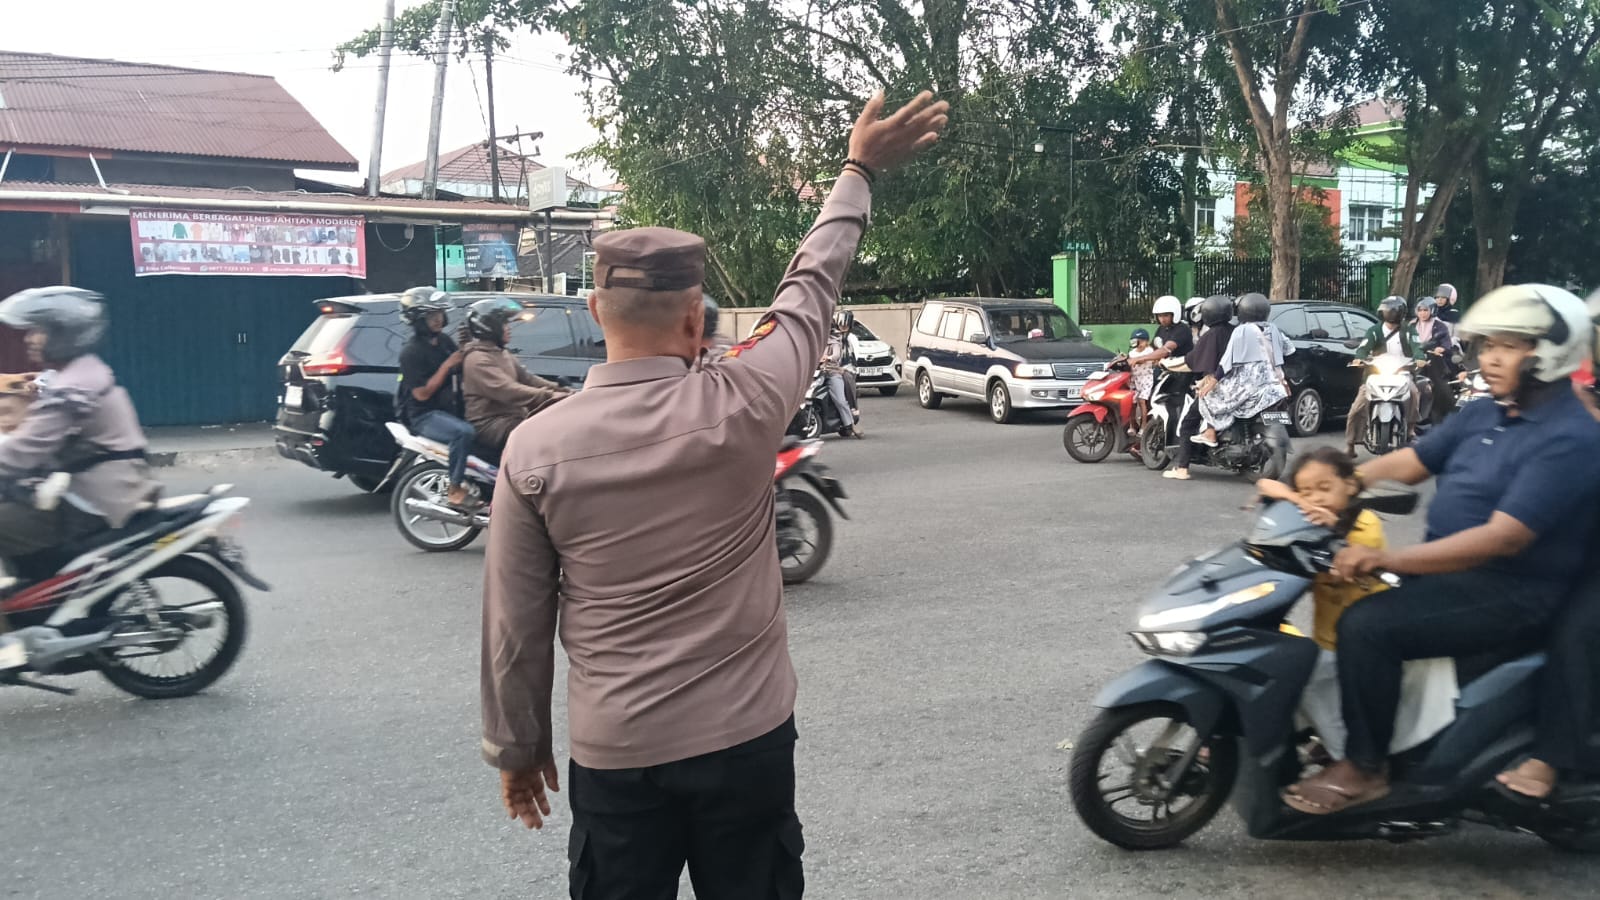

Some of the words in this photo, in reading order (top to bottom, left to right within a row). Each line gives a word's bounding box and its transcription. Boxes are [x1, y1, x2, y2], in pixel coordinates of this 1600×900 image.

[132, 211, 190, 220] MENERIMA
[192, 213, 243, 222] BERBAGAI
[244, 215, 271, 223] JENIS
[272, 216, 313, 225] JAHITAN
[315, 217, 362, 227] MODEREN
